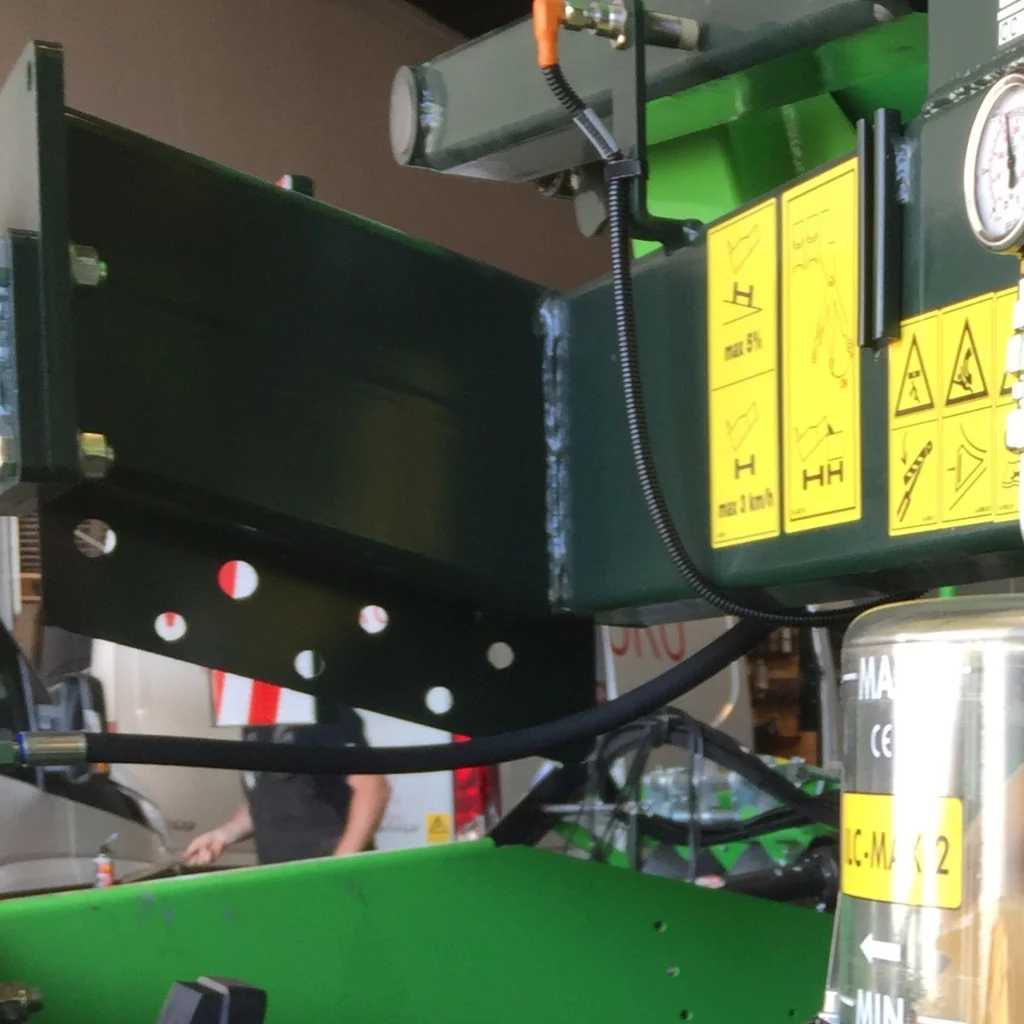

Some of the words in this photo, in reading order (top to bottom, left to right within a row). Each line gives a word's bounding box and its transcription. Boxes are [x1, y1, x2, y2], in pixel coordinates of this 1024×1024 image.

[724, 341, 744, 361] max
[718, 501, 737, 518] max
[859, 654, 902, 701] MA
[936, 834, 949, 875] 2
